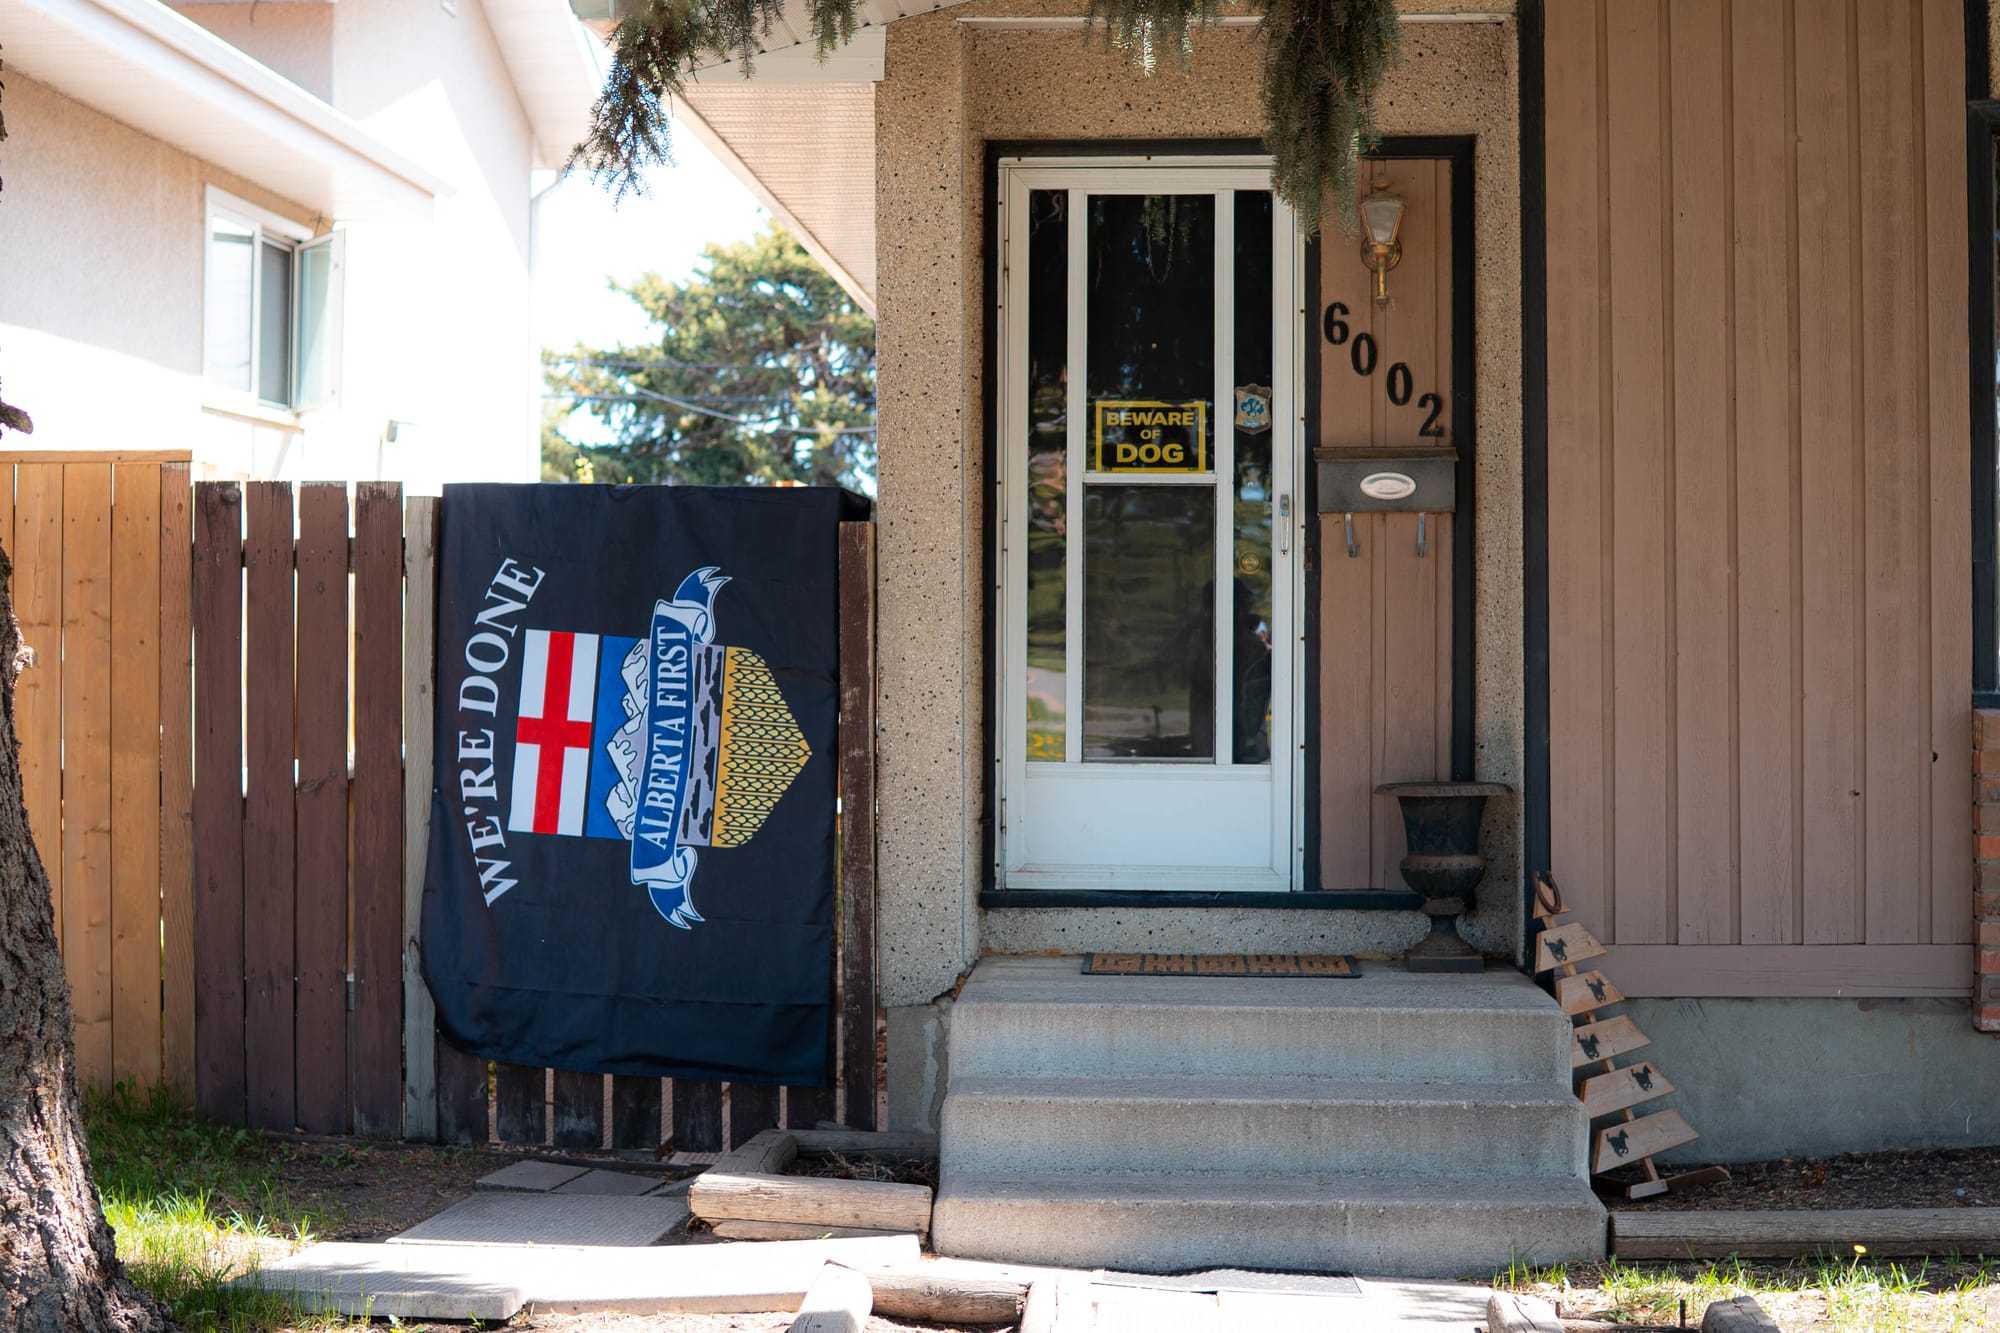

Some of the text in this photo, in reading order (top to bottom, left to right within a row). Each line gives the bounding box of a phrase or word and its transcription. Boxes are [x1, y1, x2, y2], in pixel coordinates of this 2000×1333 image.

[1323, 301, 1444, 437] 6002
[1106, 411, 1195, 427] BEWARE
[1116, 443, 1184, 463] DOG
[1140, 429, 1161, 440] OF
[457, 557, 546, 908] WE'RE DONE
[638, 625, 689, 850] ALBERTA FIRST
